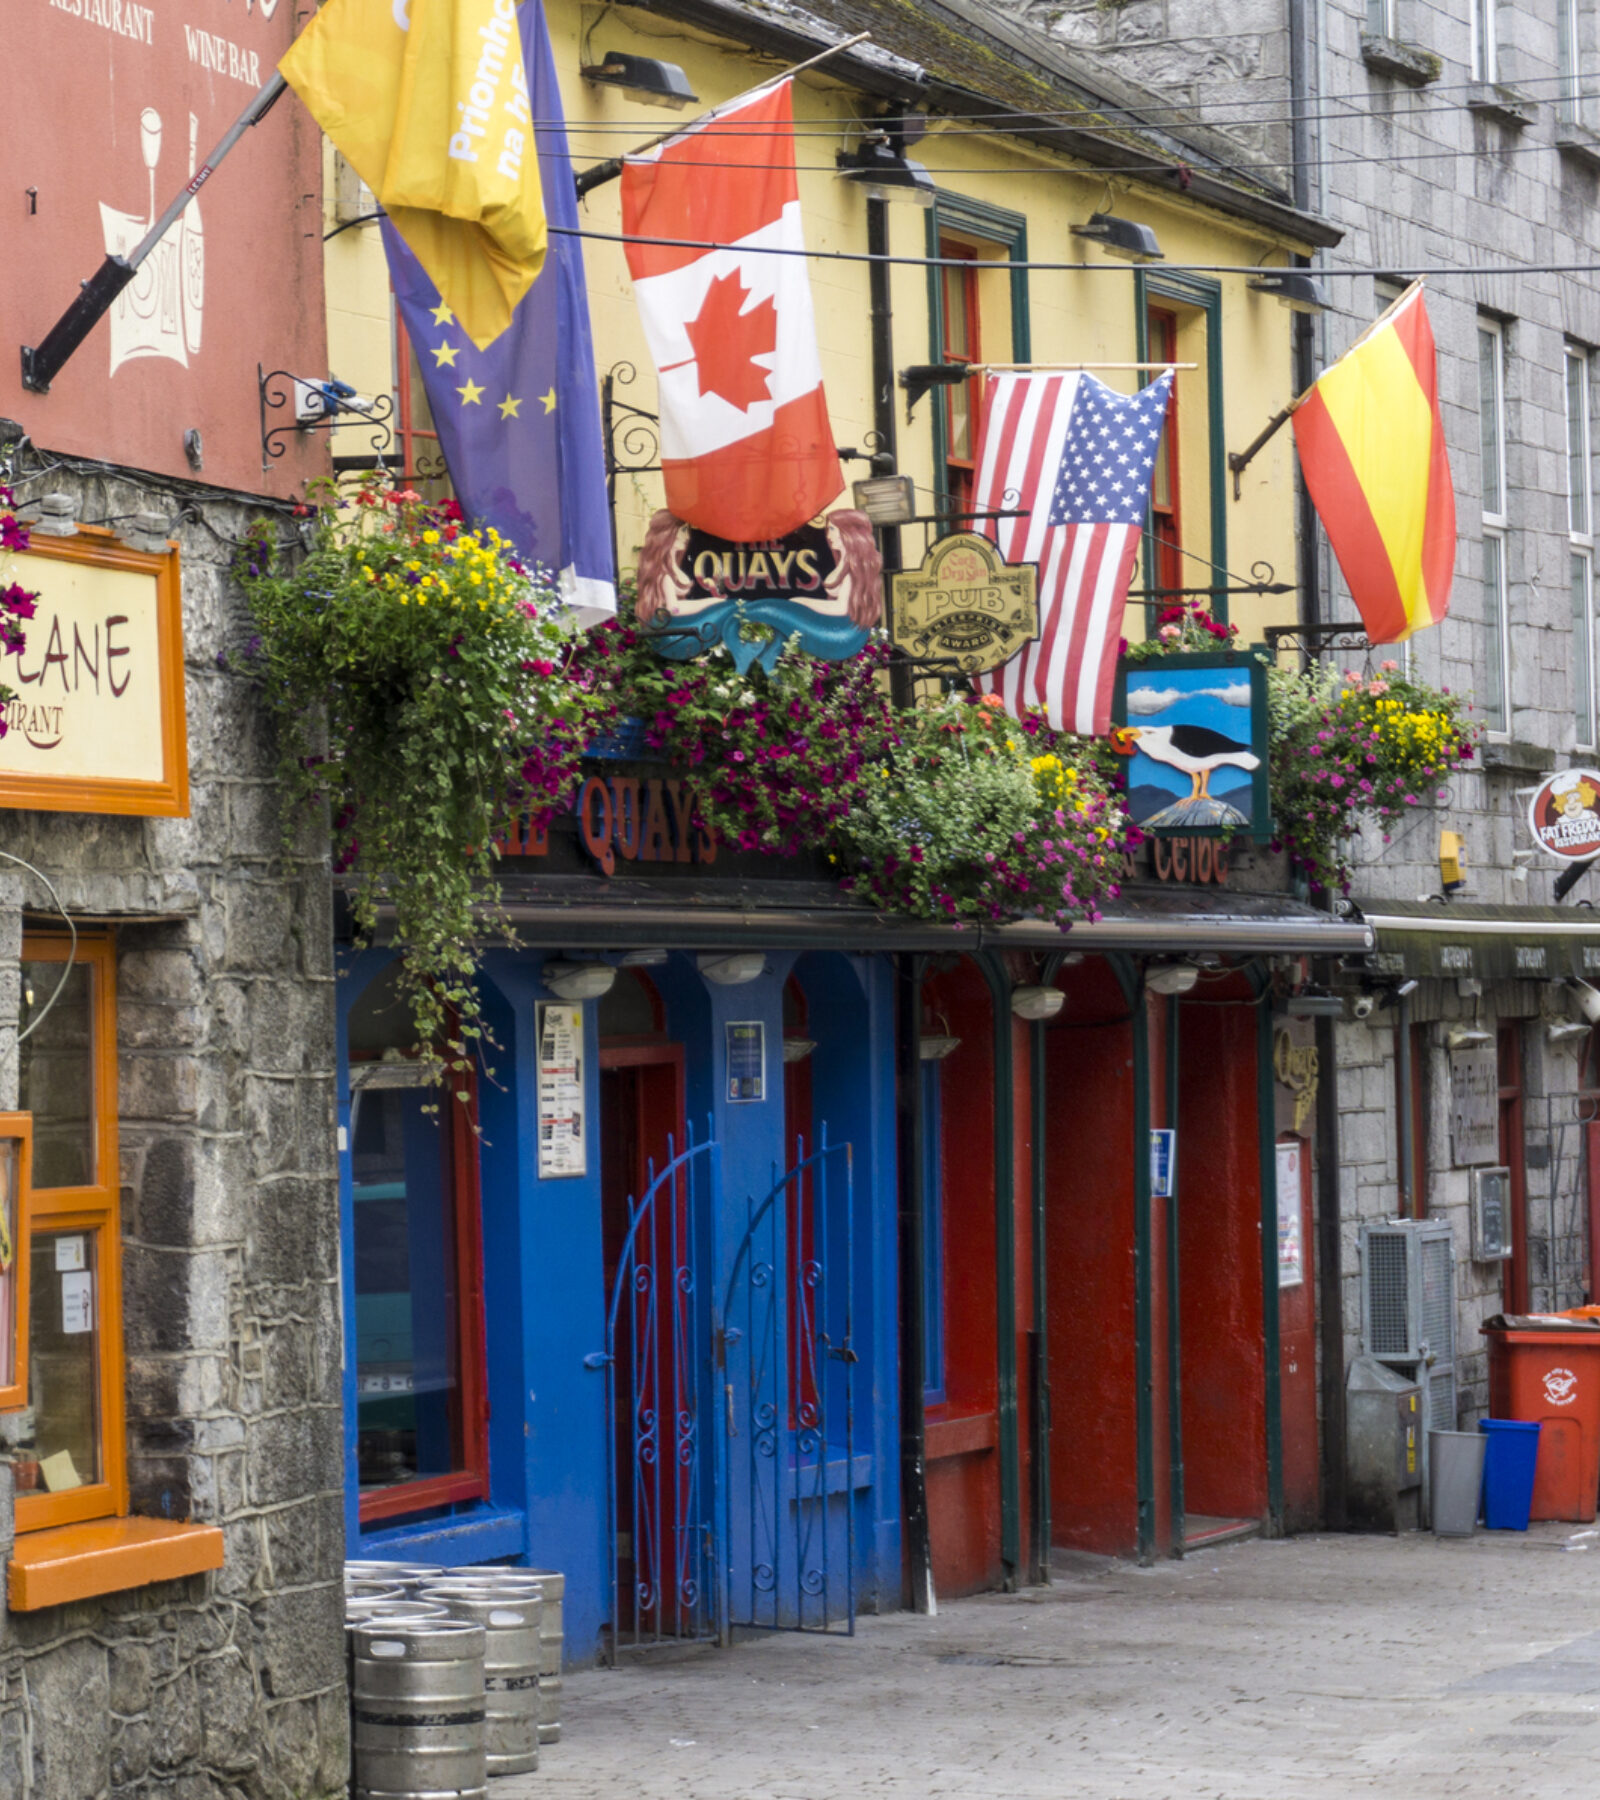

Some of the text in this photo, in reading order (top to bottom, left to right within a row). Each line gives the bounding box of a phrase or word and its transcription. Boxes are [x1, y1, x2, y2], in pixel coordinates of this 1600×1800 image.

[49, 0, 154, 46] TAURANT
[184, 24, 261, 88] WINE BAR
[497, 127, 526, 182] na
[694, 549, 821, 599] QUAYS
[925, 587, 1005, 621] PUB
[16, 613, 131, 698] LANE
[941, 634, 990, 649] AWARD
[1540, 824, 1559, 841] FAT
